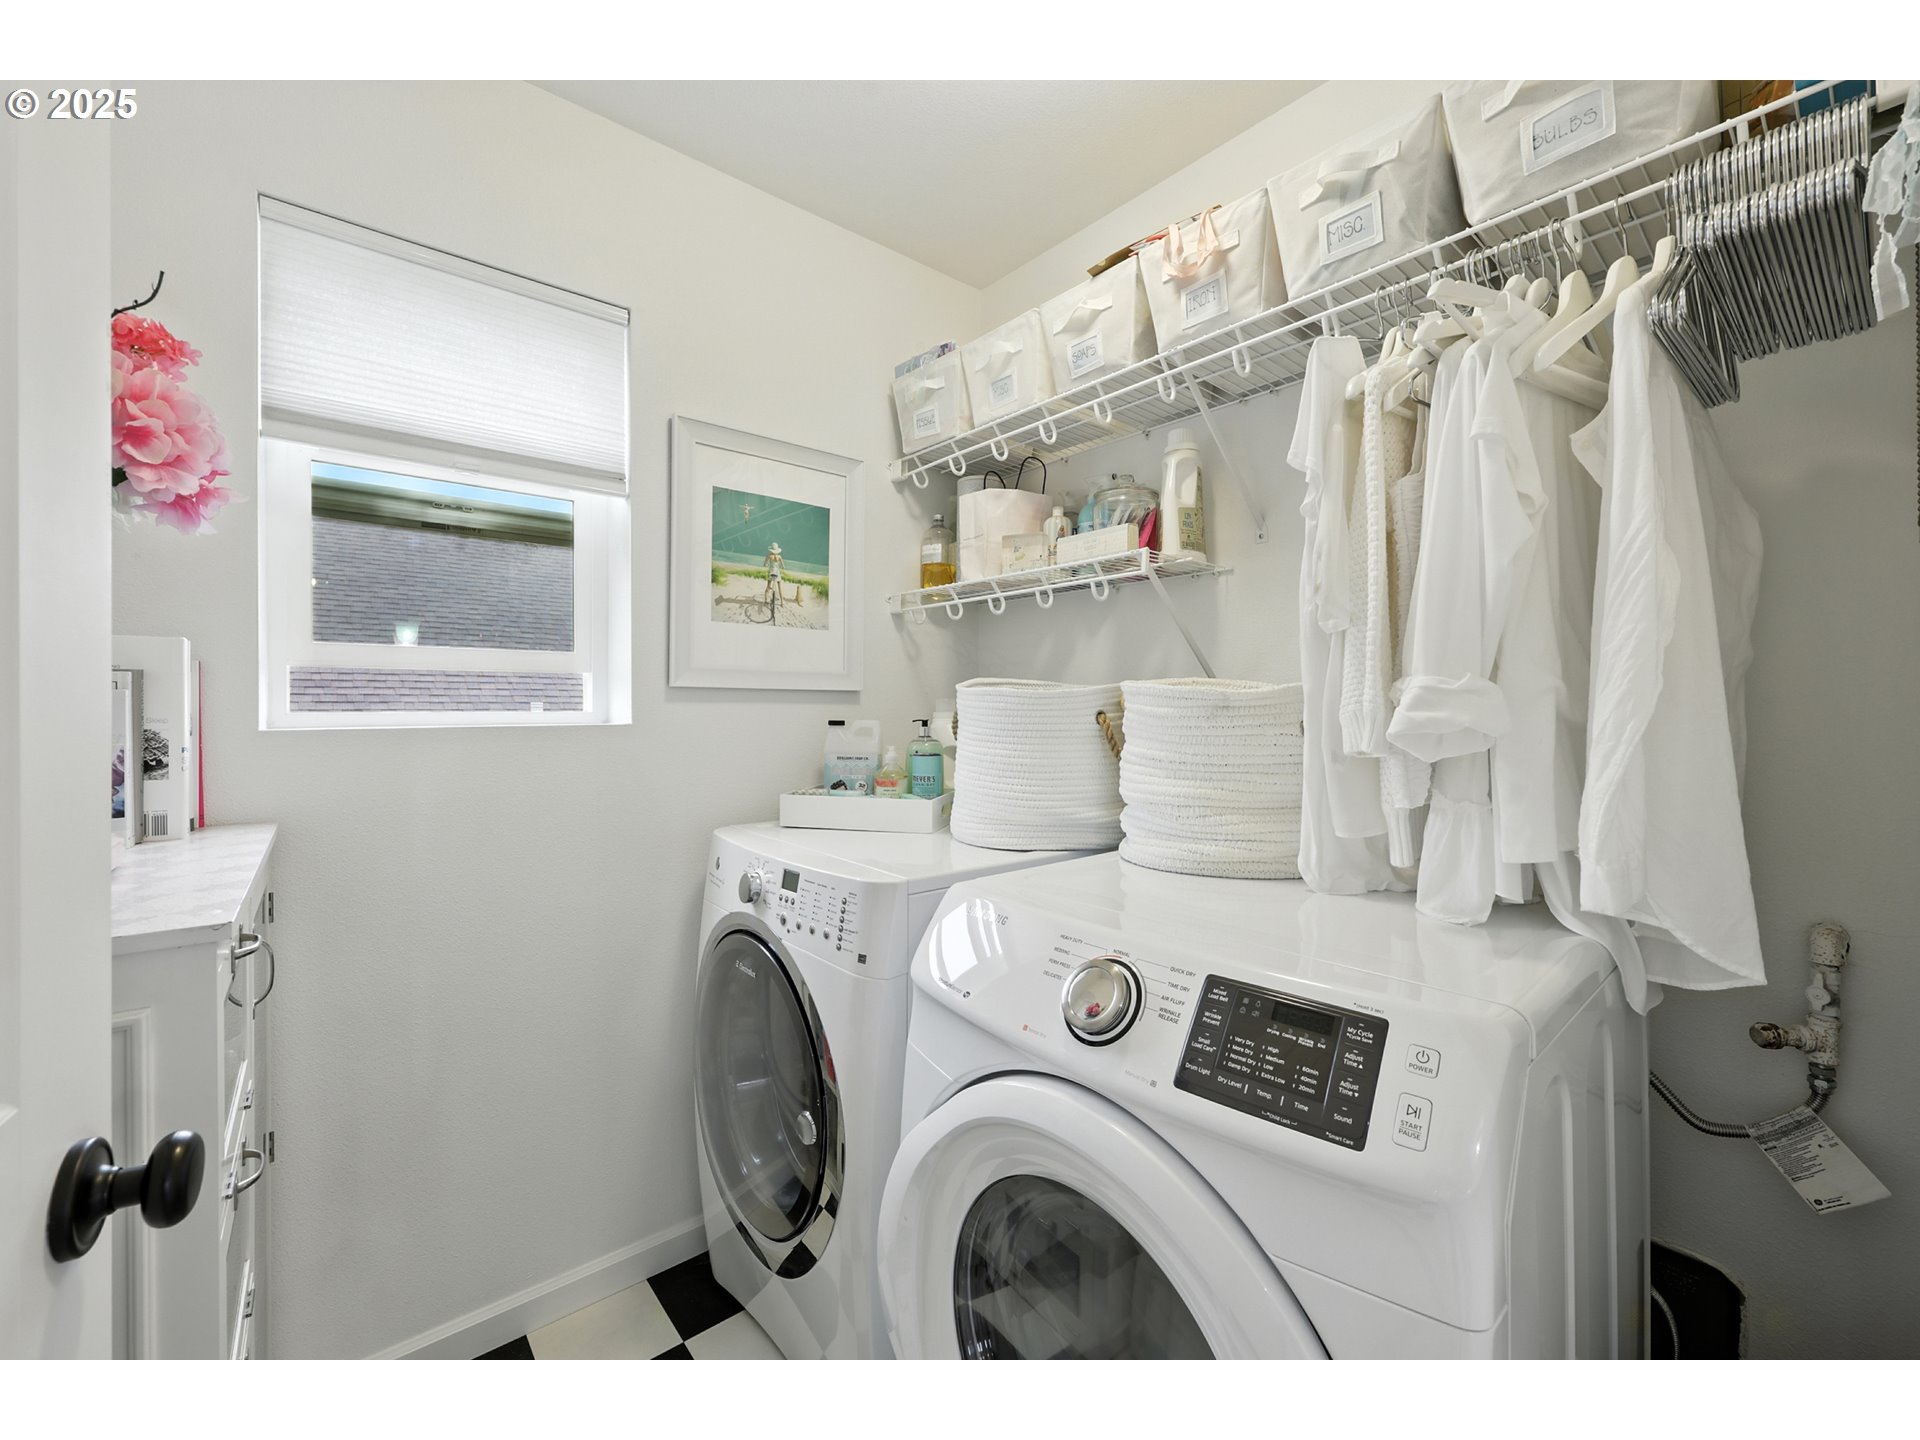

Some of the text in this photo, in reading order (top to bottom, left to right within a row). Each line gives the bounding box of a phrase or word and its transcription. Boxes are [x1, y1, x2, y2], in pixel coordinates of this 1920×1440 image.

[1533, 107, 1598, 151] BULBS
[1188, 285, 1217, 313] IRON
[1072, 344, 1097, 364] SOAPS
[1169, 966, 1185, 975] QUICK
[1167, 981, 1191, 993] TIME DRY
[1161, 994, 1185, 1007] AIR FLUFF
[1159, 1007, 1181, 1019] WRINKLE
[1158, 1013, 1179, 1025] RELEASE
[1266, 1027, 1280, 1036] Drying
[1347, 1026, 1374, 1039] My Cycle
[1191, 1041, 1203, 1049] Load
[1198, 1036, 1211, 1045] Small
[1234, 1036, 1255, 1047] Very Dry
[1361, 1036, 1373, 1044] Save
[1232, 1044, 1254, 1056] More Dry
[1267, 1046, 1280, 1054] High
[1229, 1053, 1257, 1066] Normal Dry
[1265, 1054, 1285, 1065] Medium
[1343, 1058, 1358, 1068] Time
[1344, 1052, 1364, 1063] Adjust
[1185, 1062, 1211, 1076] Drum Light
[1228, 1061, 1251, 1074] Damp Dry
[1263, 1063, 1274, 1071] Low
[1302, 1066, 1319, 1076] 60min
[1408, 1062, 1434, 1075] POWER
[1217, 1075, 1243, 1089] Dry Level
[1261, 1072, 1286, 1084] Extra Low
[1300, 1075, 1317, 1086] 40min
[1298, 1084, 1315, 1095] 20min
[1340, 1080, 1359, 1091] Adjust
[1256, 1089, 1272, 1100] Temp.
[1339, 1087, 1353, 1097] Time
[1294, 1101, 1309, 1112] Time
[1280, 1116, 1291, 1125] Lock
[1333, 1113, 1353, 1124] Sound
[1400, 1119, 1423, 1131] START
[1398, 1128, 1421, 1141] PAUSE
[1343, 1136, 1354, 1146] Care
